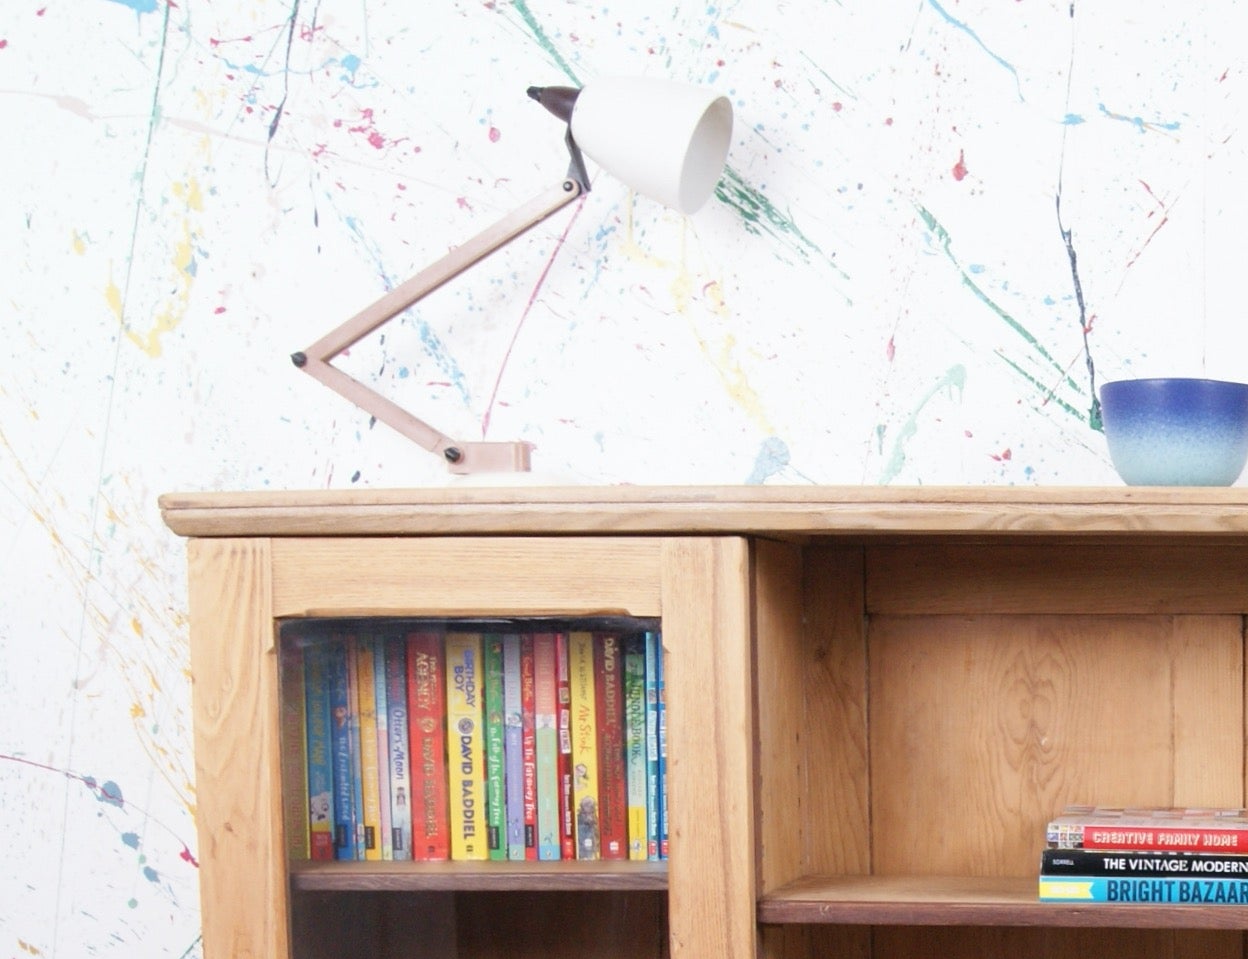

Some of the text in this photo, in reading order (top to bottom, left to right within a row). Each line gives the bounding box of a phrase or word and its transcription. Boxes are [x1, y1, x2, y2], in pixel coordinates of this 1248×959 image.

[416, 652, 431, 711] AGENCY
[454, 666, 464, 692] BOY
[463, 650, 475, 707] BIRTHDAY
[604, 637, 616, 725] DAVID BADDIEL
[392, 709, 405, 743] Otter's
[579, 724, 592, 754] Stink
[631, 728, 641, 758] BOOK
[393, 746, 405, 779] Moon
[461, 736, 475, 839] DAVID BADDIEL
[489, 775, 500, 806] Faraway
[525, 762, 535, 801] Faraway
[492, 808, 502, 825] Tree
[526, 803, 536, 820] Tree
[1093, 832, 1153, 843] CREATIVE
[1157, 833, 1201, 845] FAMILY
[1203, 834, 1238, 846] HOME
[1103, 858, 1126, 870] THE
[1128, 859, 1188, 871] VINTAGE
[1107, 880, 1175, 902] BRIGHT
